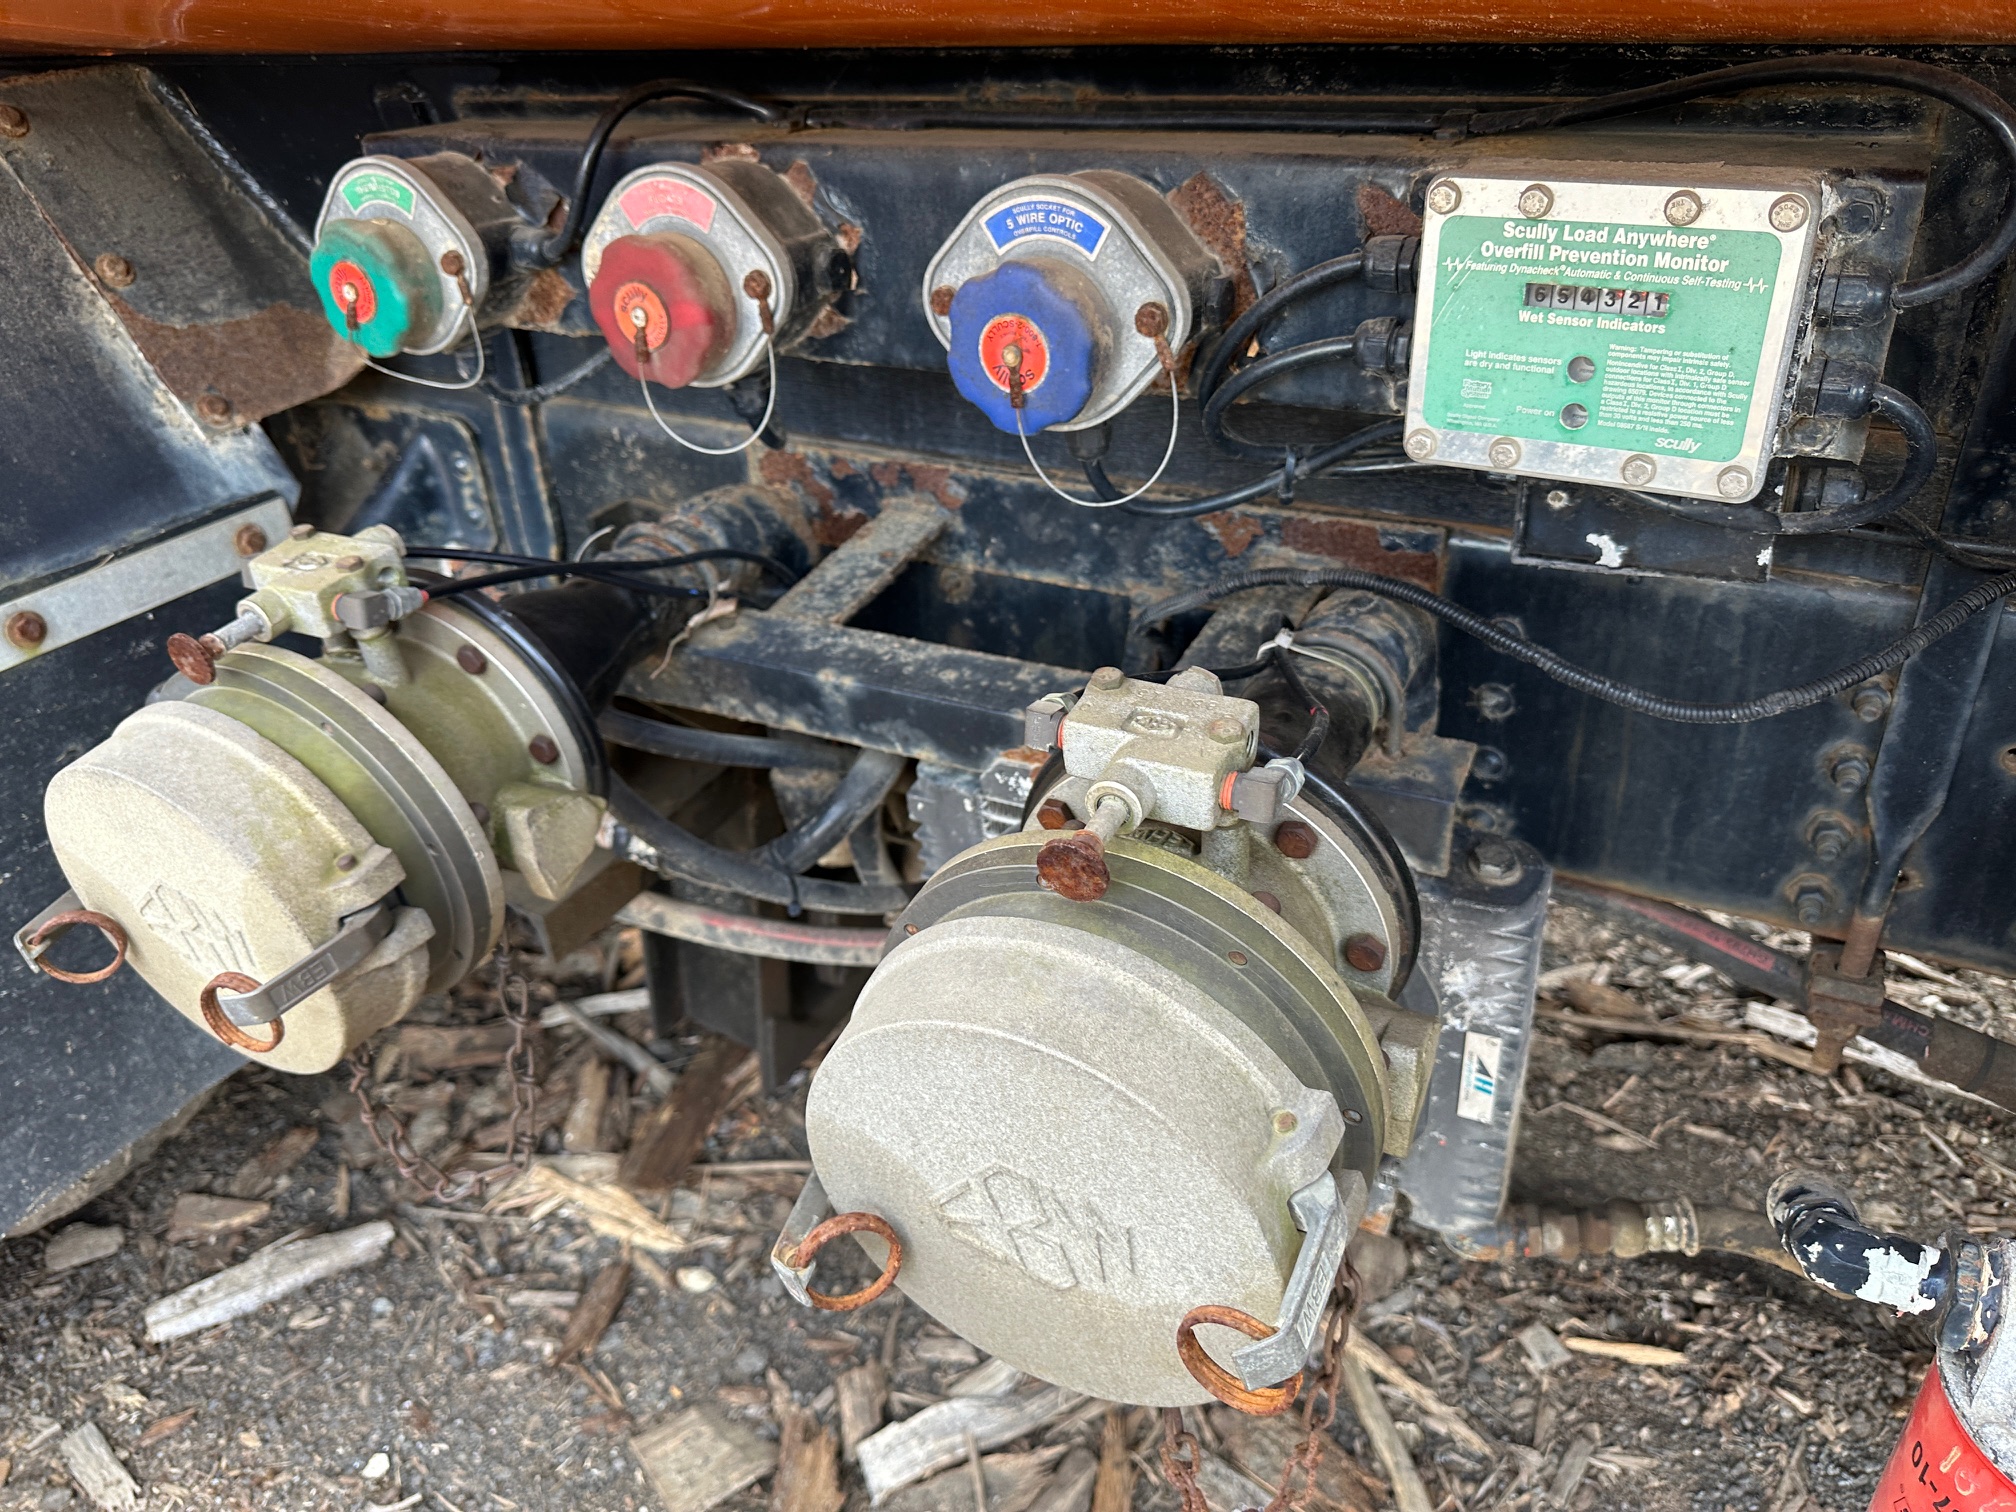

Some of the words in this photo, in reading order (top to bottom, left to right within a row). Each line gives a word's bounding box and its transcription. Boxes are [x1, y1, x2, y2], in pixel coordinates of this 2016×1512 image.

[1012, 204, 1035, 215] SCULLY
[1036, 203, 1061, 212] SOCKET
[1062, 207, 1076, 217] FOR
[1006, 218, 1015, 230] 5
[1016, 212, 1045, 226] WIRE
[1049, 213, 1084, 233] OPTIC
[1013, 226, 1042, 237] OVERFILL
[1043, 226, 1077, 240] CONTROLS
[1503, 221, 1558, 243] Scully
[1563, 224, 1609, 243] Load
[1481, 241, 1544, 260] Overfill
[1549, 245, 1649, 267] Prevention
[1654, 252, 1730, 273] Monitor
[1465, 260, 1508, 275] Featuring
[1563, 268, 1612, 280] Automatic
[1614, 271, 1622, 281] &
[1624, 271, 1680, 285] Continuous
[1682, 275, 1742, 292] Self-Testing
[1519, 310, 1544, 324] Wet
[1547, 313, 1593, 328] Sensor
[1596, 317, 1666, 334] Indicators
[1465, 349, 1487, 360] Light
[1488, 351, 1527, 362] indicates
[1528, 356, 1563, 366] sensors
[1608, 351, 1646, 360] components
[1647, 355, 1661, 363] may
[1661, 356, 1682, 364] impair
[1683, 358, 1709, 366] intrinsic
[1710, 361, 1731, 369] safety.
[1609, 344, 1637, 353] Warning:
[1640, 346, 1674, 357] Tampering
[1683, 351, 1720, 360] substitution
[992, 364, 1036, 386] sclly
[1479, 360, 1494, 370] dry
[1494, 361, 1511, 370] and
[1513, 363, 1555, 374] functional
[1606, 366, 1631, 374] outdoor
[1631, 369, 1660, 377] locations
[1675, 373, 1712, 384] intrinsically
[1607, 359, 1649, 369] Nonincendive
[1660, 364, 1678, 372] Class
[1707, 369, 1728, 380] Group
[1728, 371, 1735, 379] D,
[1605, 374, 1643, 382] connections
[1700, 382, 1720, 392] Group
[1636, 382, 1667, 392] locations,
[1675, 387, 1712, 396] accordance
[1727, 392, 1749, 402] Scully
[1649, 391, 1674, 399] Devices
[1674, 394, 1708, 403] connected
[1672, 400, 1697, 409] through
[1698, 404, 1734, 412] connectors
[1516, 406, 1543, 417] Power
[1651, 404, 1671, 413] Group
[1678, 407, 1703, 415] location
[1649, 425, 1670, 434] inside.
[1655, 437, 1703, 454] scully
[281, 960, 328, 1002] EBW
[1302, 1262, 1328, 1338] EBW
